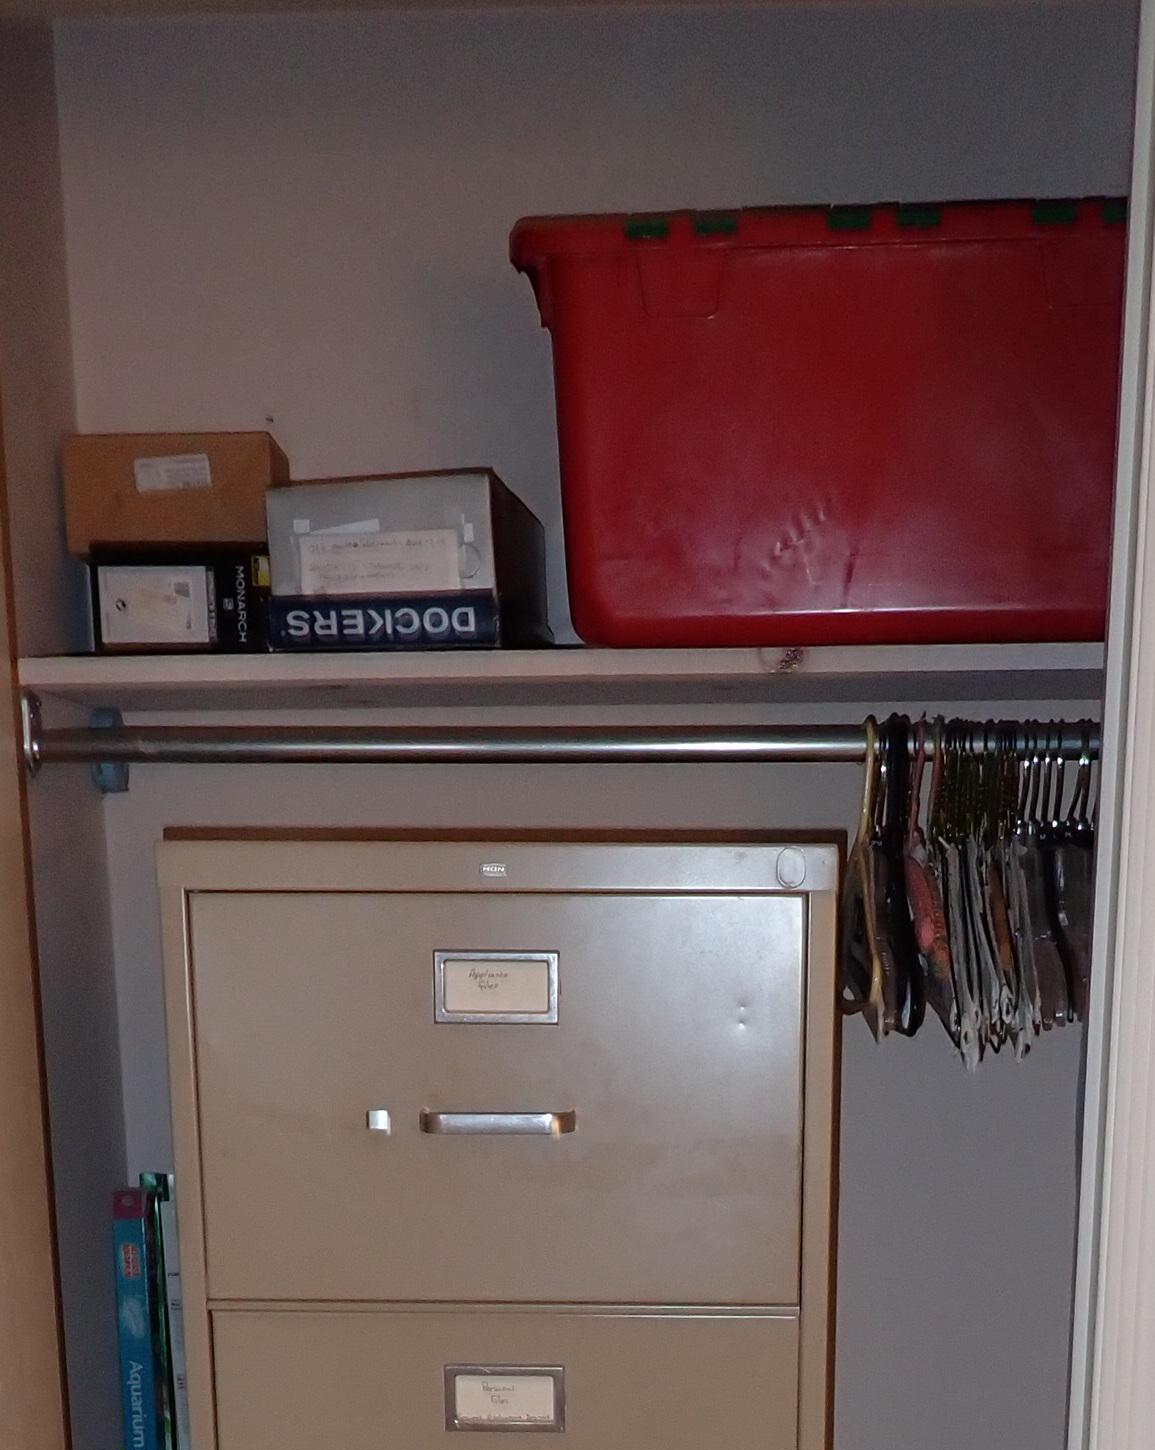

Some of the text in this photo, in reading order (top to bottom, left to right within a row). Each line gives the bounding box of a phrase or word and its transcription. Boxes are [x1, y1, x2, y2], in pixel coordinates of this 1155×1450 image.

[235, 566, 247, 642] MONARCH
[286, 607, 476, 636] DOCKERS
[127, 1360, 147, 1448] Aquarium
